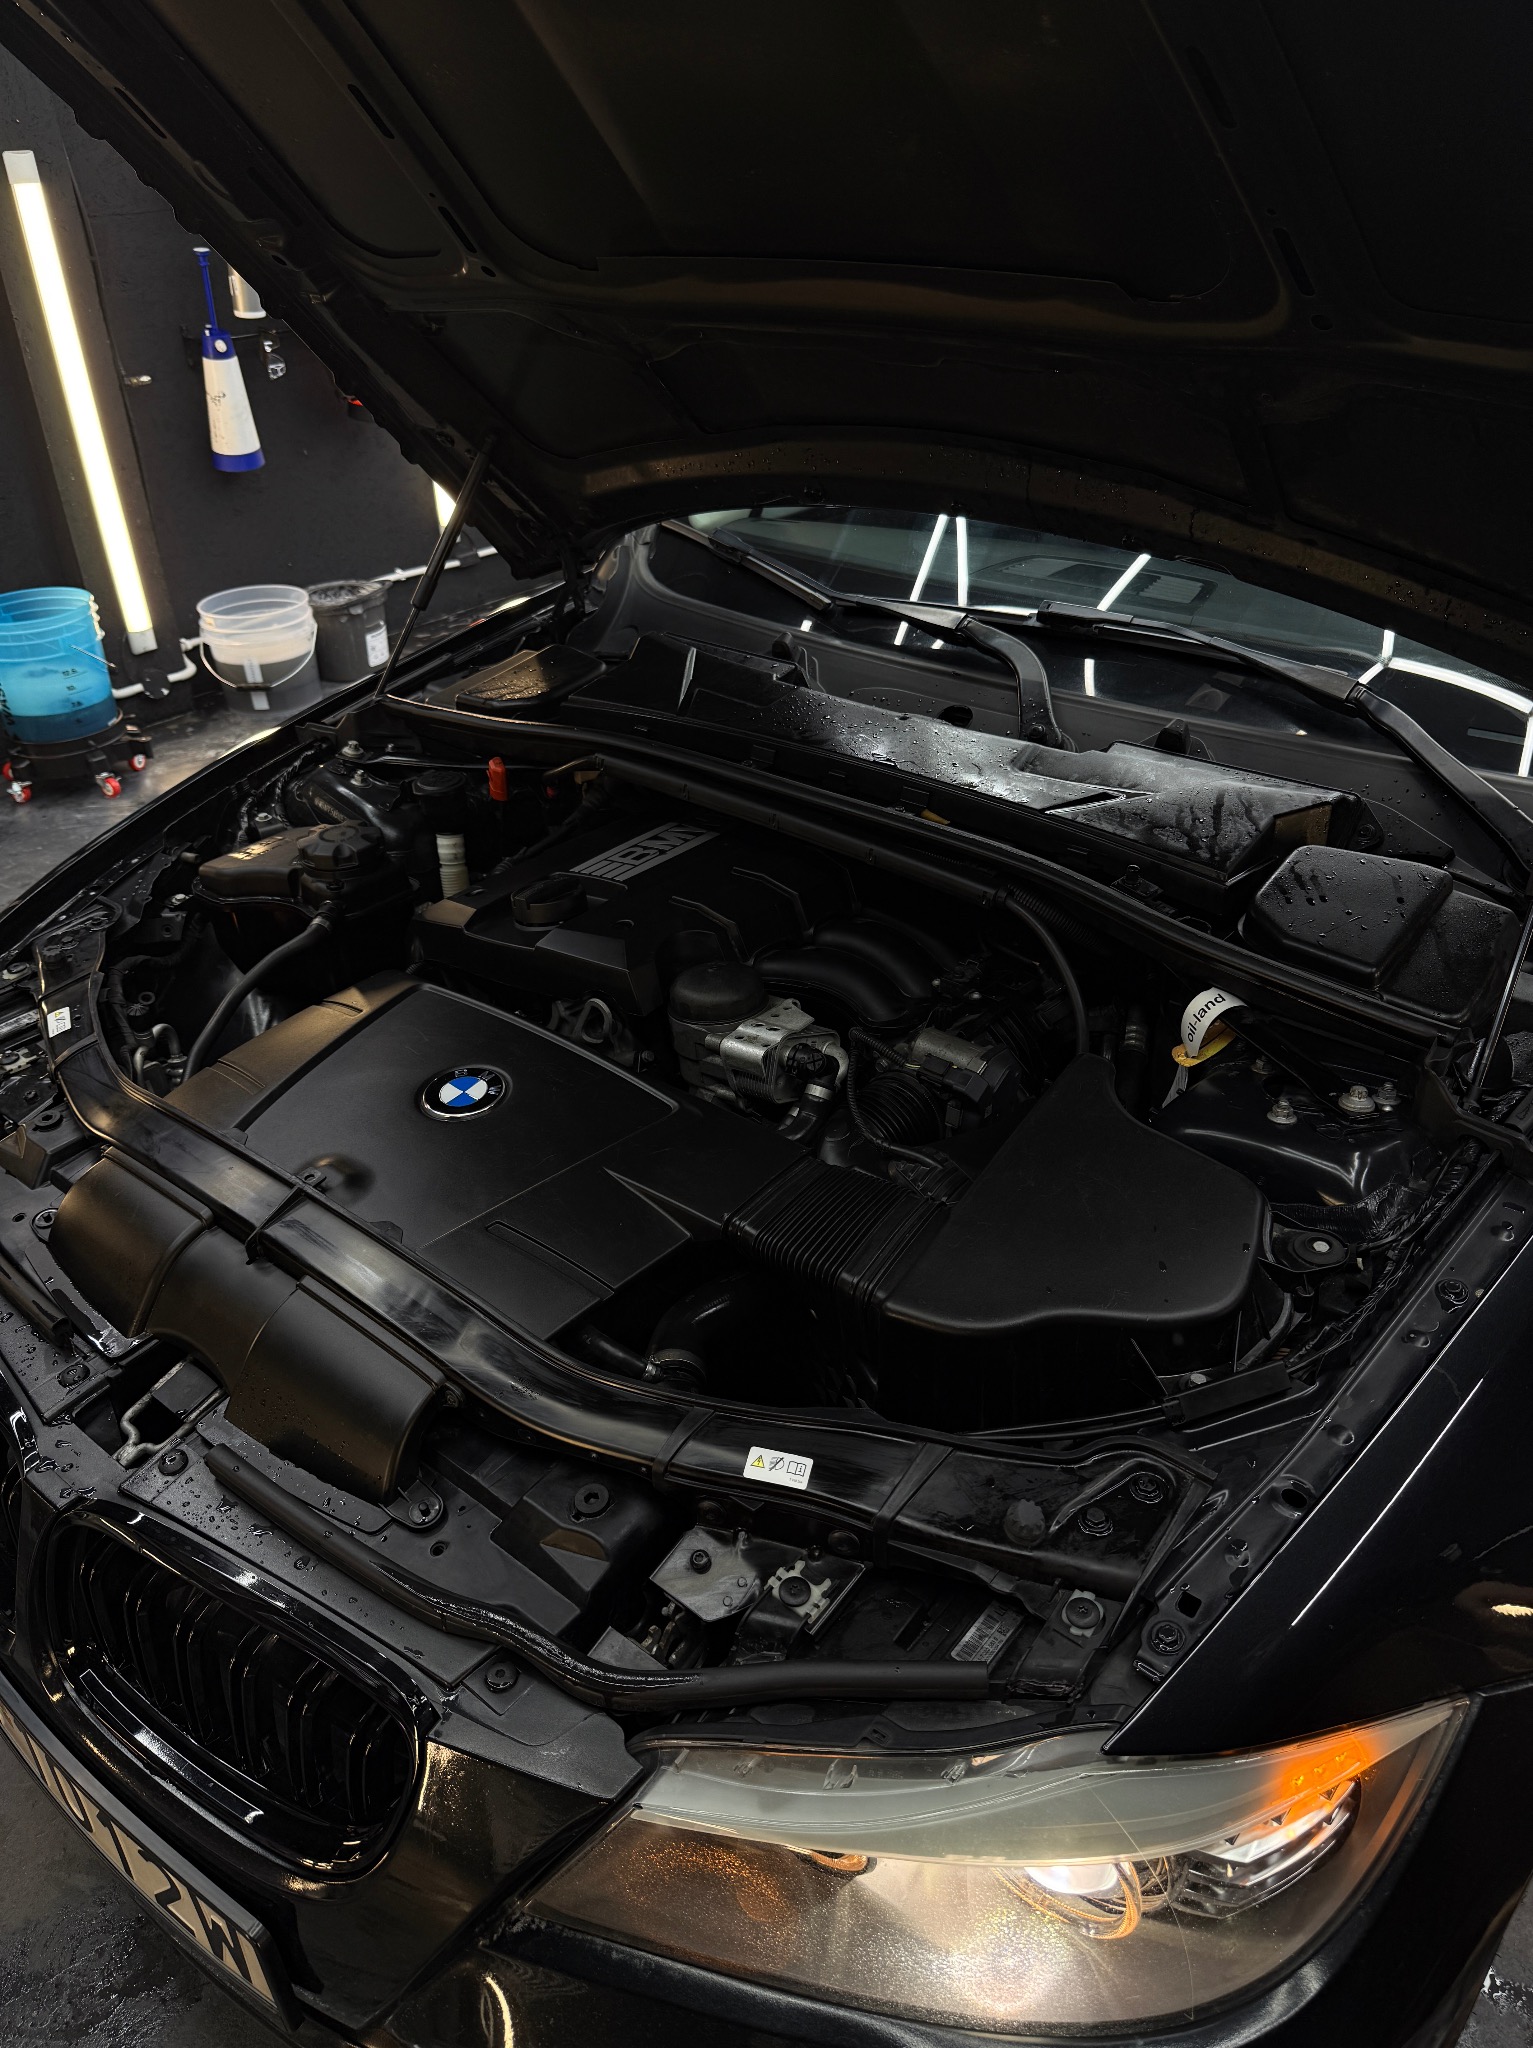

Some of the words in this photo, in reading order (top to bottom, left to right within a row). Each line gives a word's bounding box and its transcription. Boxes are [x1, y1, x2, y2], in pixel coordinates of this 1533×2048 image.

[604, 823, 708, 866] BMW
[1187, 993, 1226, 1042] oil-land
[454, 1068, 502, 1096] BMW
